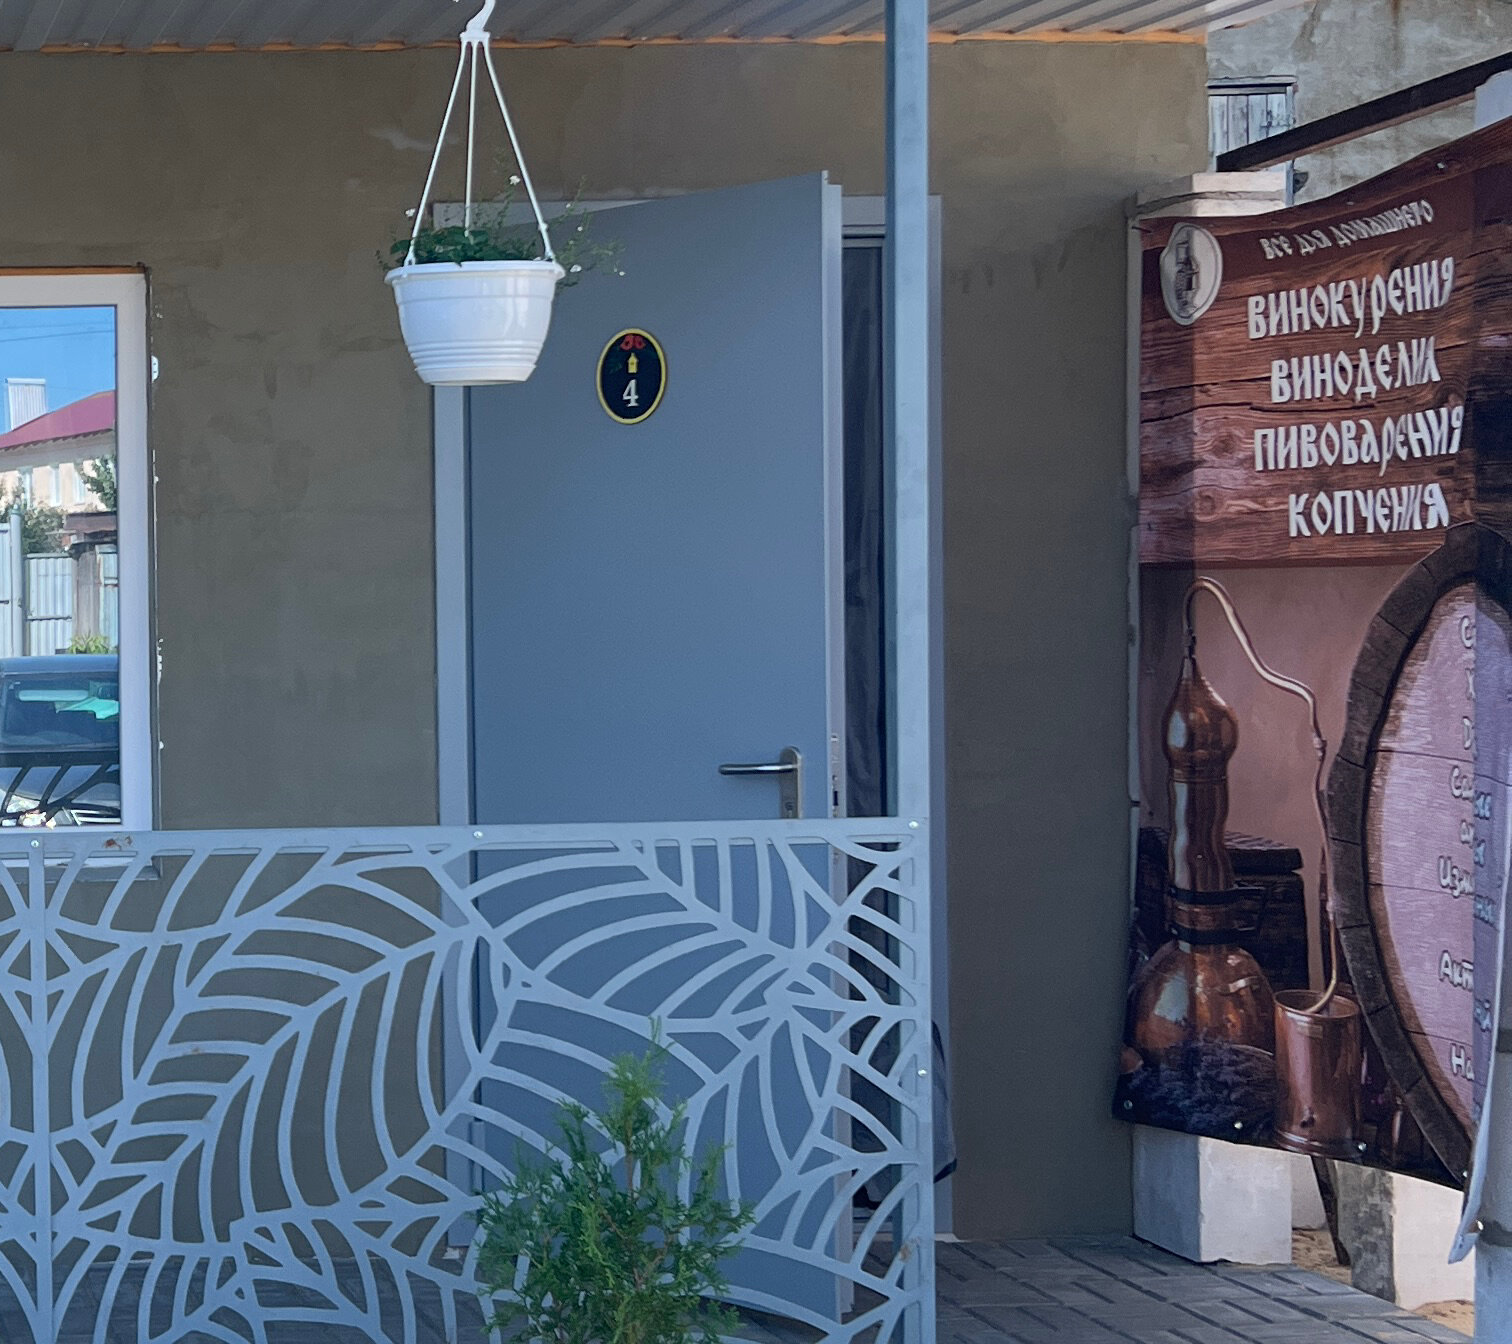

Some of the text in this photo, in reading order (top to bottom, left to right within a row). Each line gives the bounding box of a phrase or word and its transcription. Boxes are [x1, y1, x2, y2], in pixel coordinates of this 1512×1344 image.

[1329, 200, 1433, 247] ДОМАШНЕГО
[1248, 257, 1454, 339] ВИНОКУРЕНИЯ
[622, 379, 640, 407] 4
[1254, 406, 1464, 477] ПИВОВАРЕНИЯ
[1289, 483, 1450, 537] КОПЧЕНИЯ
